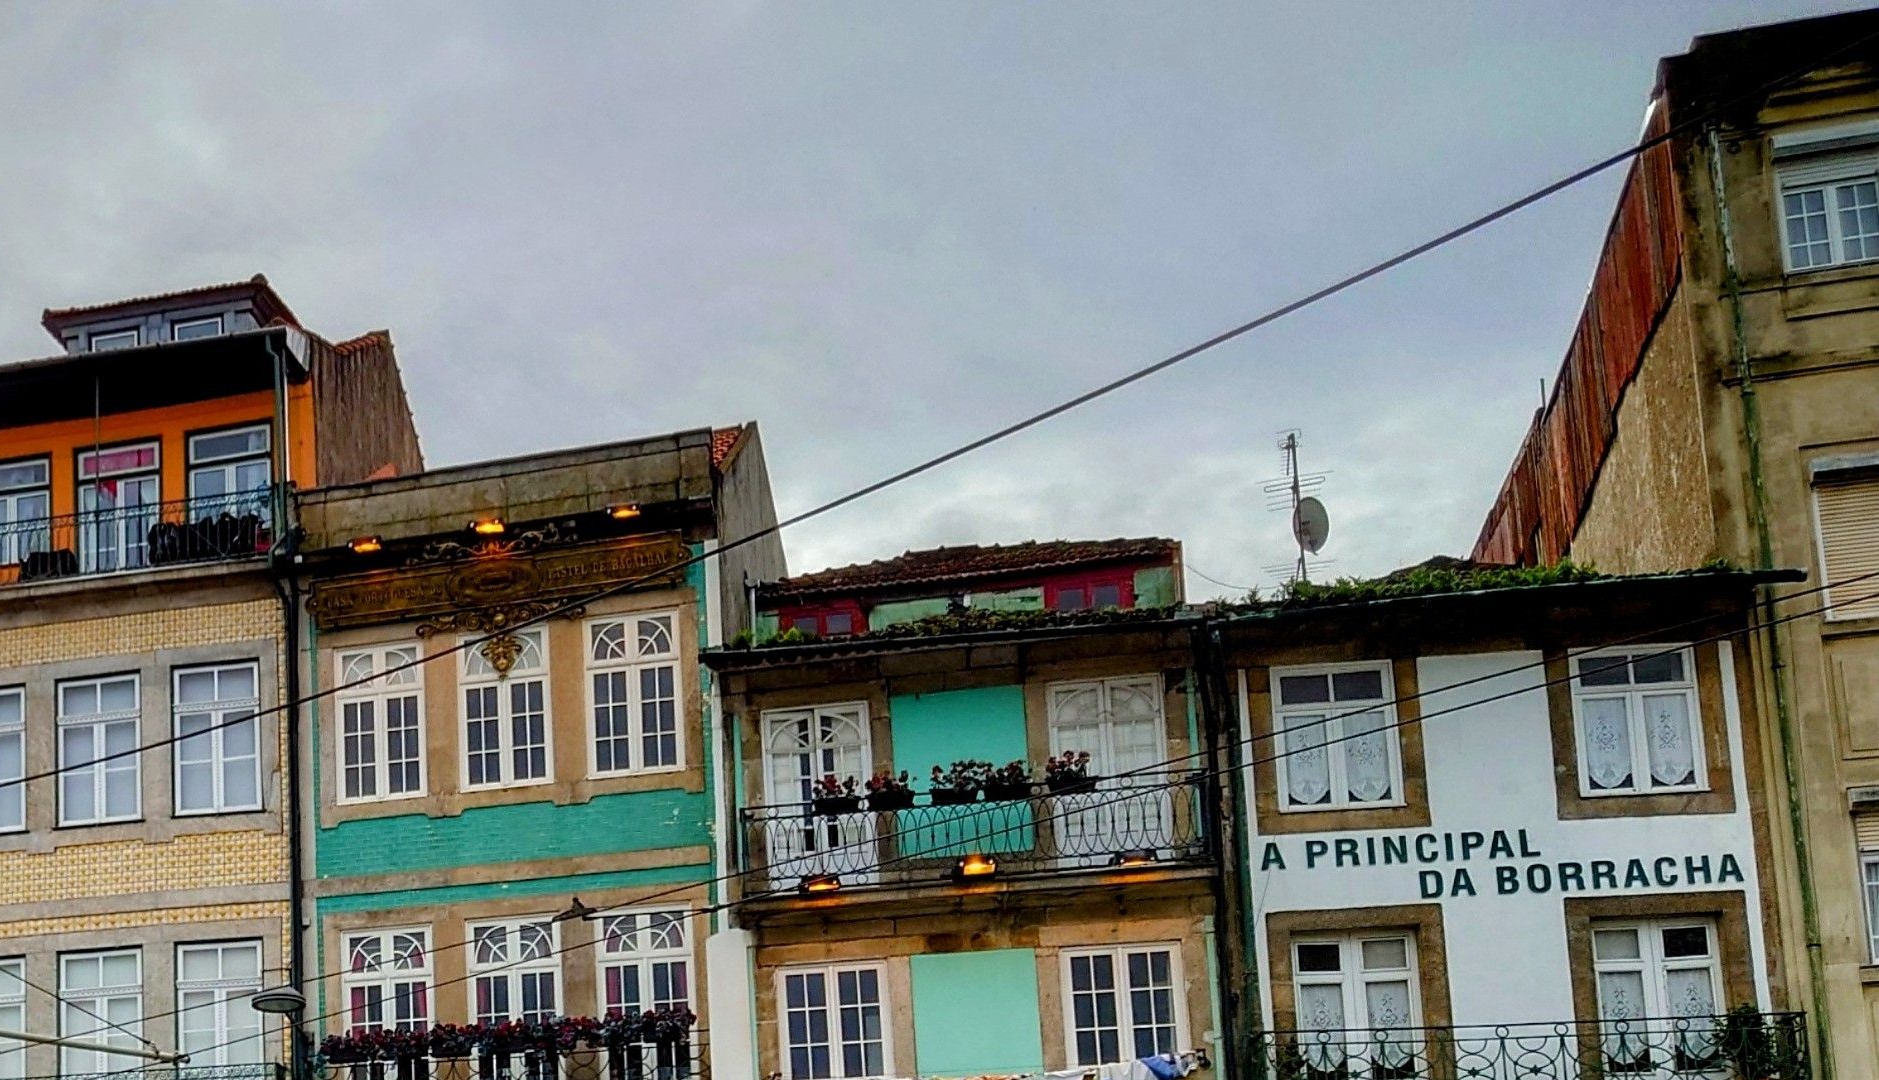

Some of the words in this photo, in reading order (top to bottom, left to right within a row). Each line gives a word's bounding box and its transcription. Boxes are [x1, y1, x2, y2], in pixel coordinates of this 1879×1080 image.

[1261, 841, 1286, 871] A
[1305, 828, 1541, 869] PRINCIPAL
[1420, 867, 1477, 899] DA
[1495, 853, 1745, 896] BORRACHA
